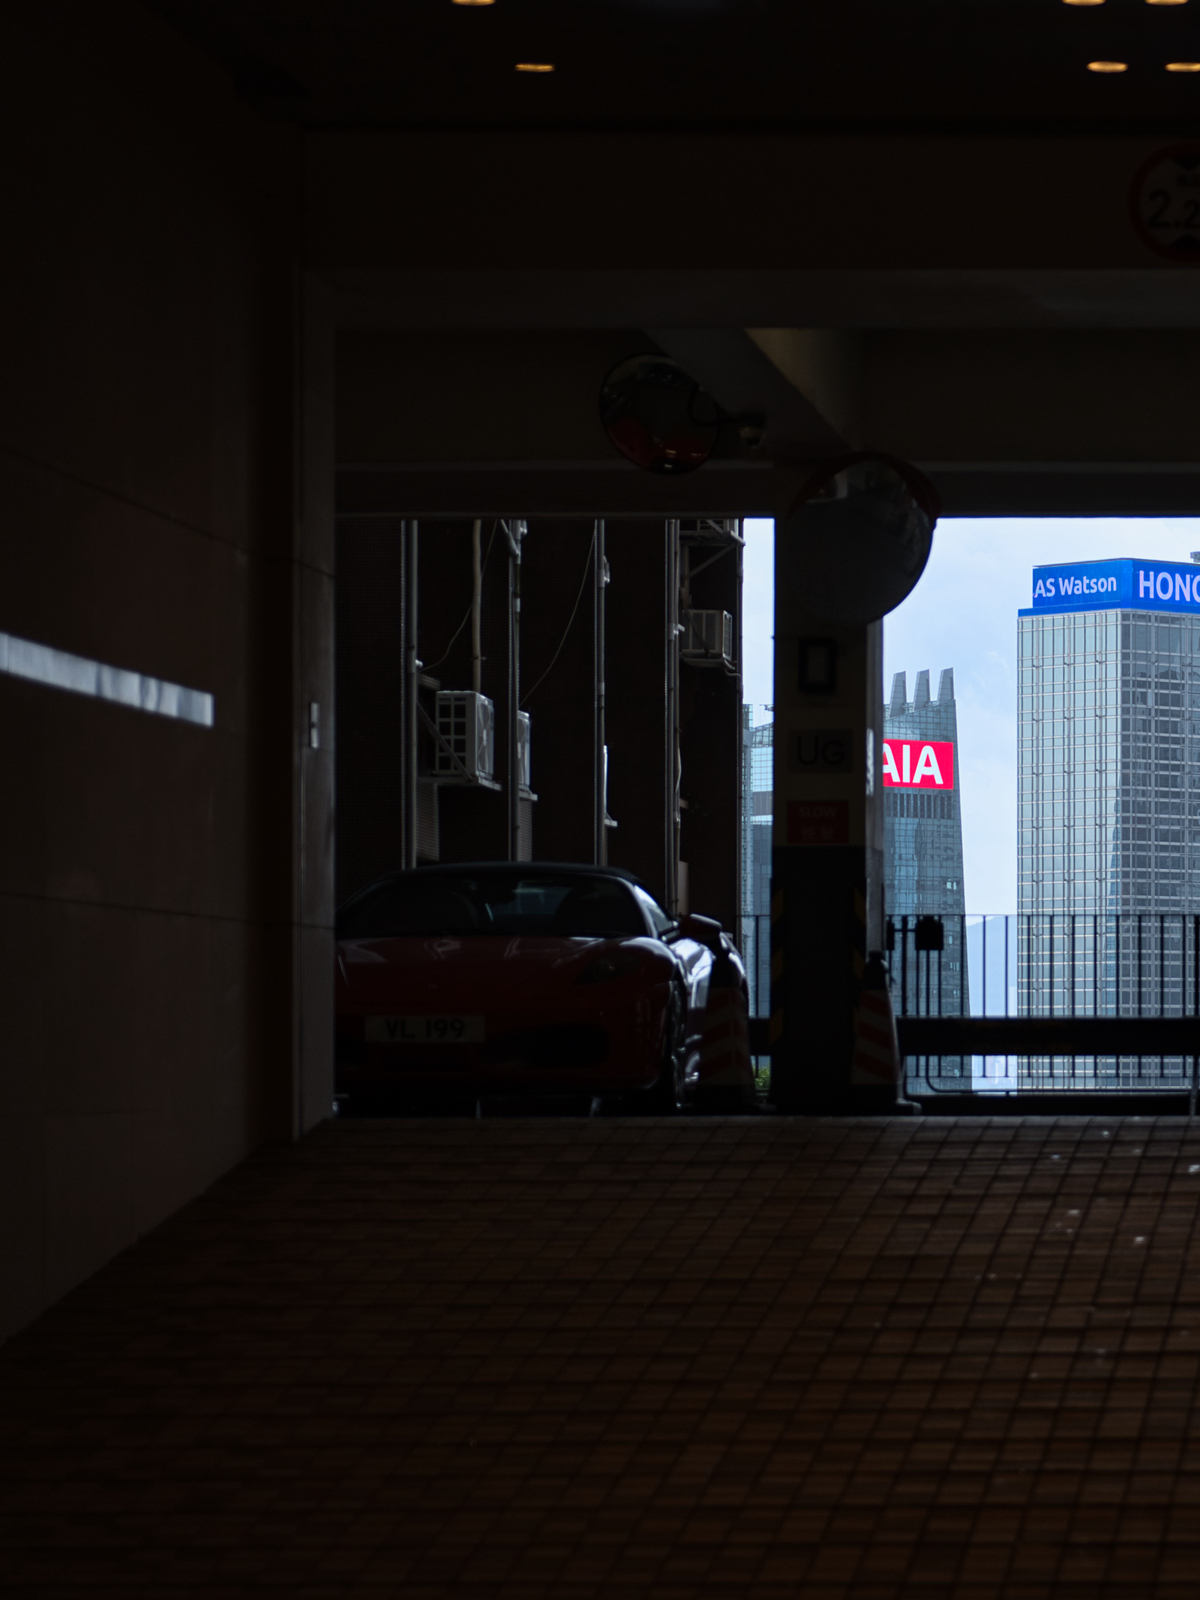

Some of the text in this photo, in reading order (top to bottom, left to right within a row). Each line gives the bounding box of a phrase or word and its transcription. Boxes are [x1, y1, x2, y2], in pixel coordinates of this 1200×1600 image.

[1033, 576, 1117, 598] AS Watson
[797, 736, 845, 765] UG
[883, 743, 944, 784] AIA
[799, 806, 837, 817] SLOW
[385, 1018, 465, 1039] VL 199
